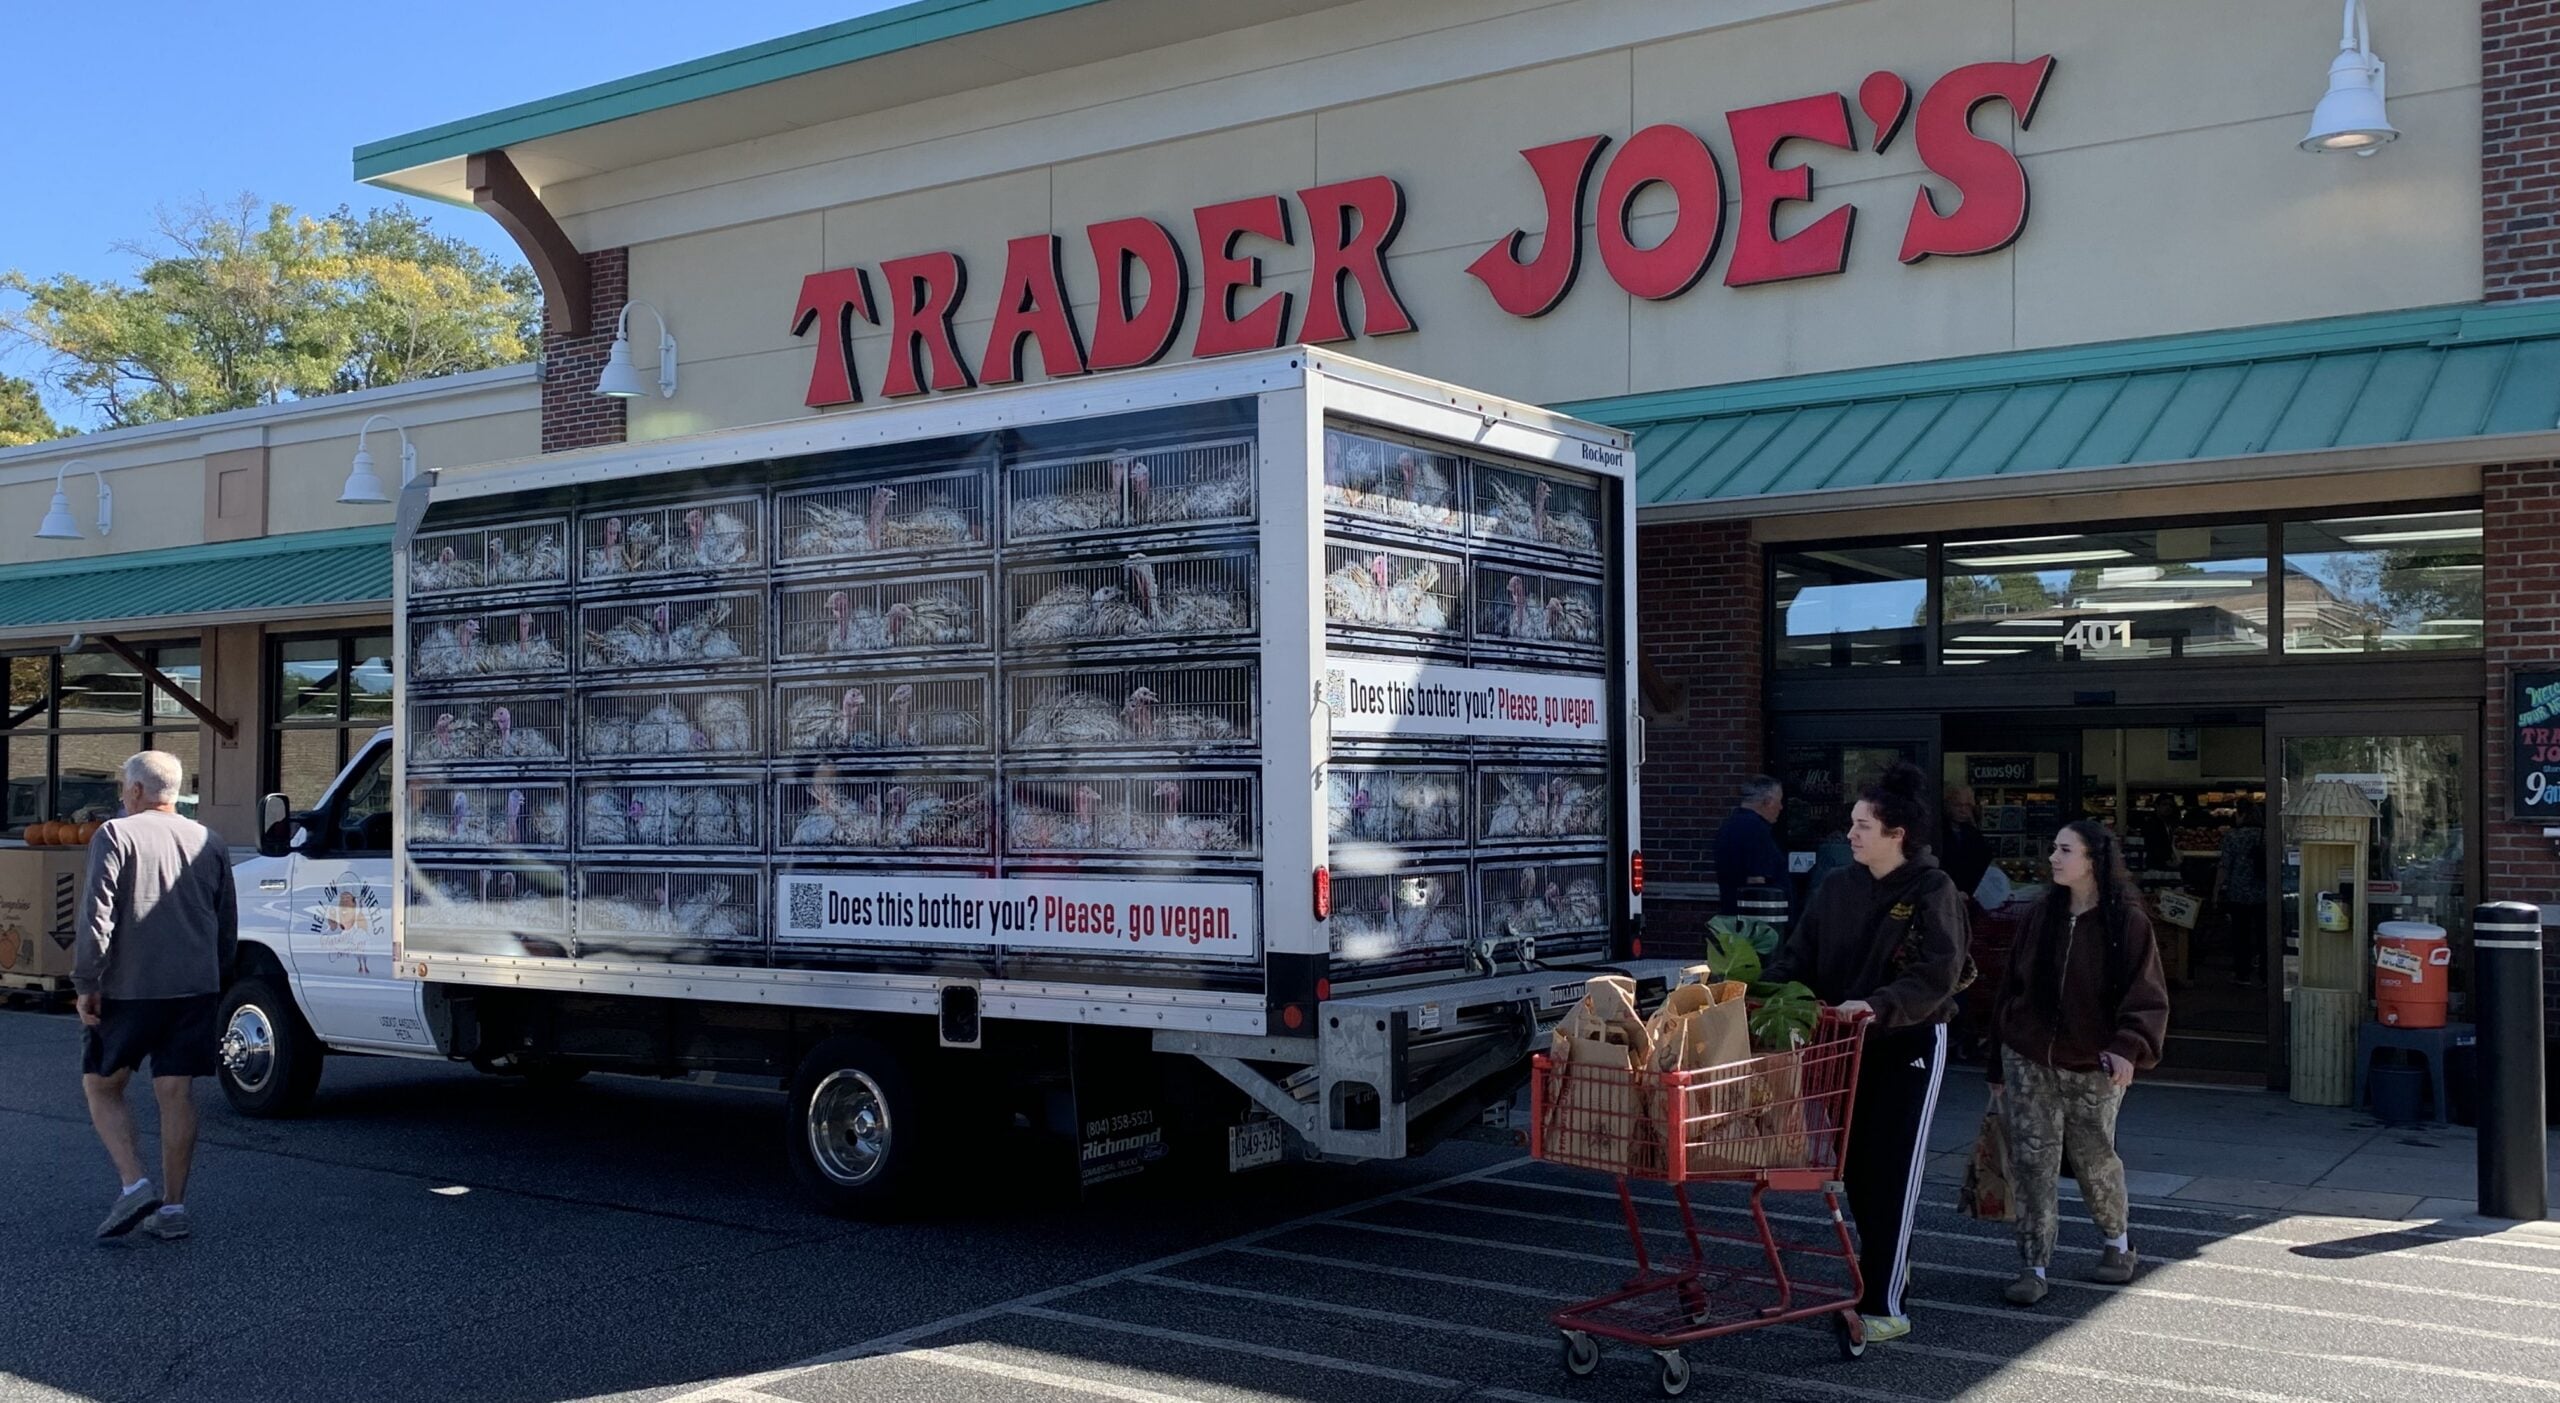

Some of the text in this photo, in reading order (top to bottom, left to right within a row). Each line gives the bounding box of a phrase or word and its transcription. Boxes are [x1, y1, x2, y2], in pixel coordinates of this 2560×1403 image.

[791, 53, 2057, 407] TRADER JOE'S
[1582, 443, 1623, 467] Rockport
[2064, 620, 2131, 650] 401
[1350, 677, 1599, 730] Does this bother you? Please, go vegan.
[1974, 766, 2004, 779] CARDS
[361, 881, 385, 937] WHEELS
[828, 889, 1238, 945] Does this bother you? Please, go vegan.
[1086, 1109, 1153, 1139] (804) 358-5521
[1082, 1126, 1161, 1161] Richmond
